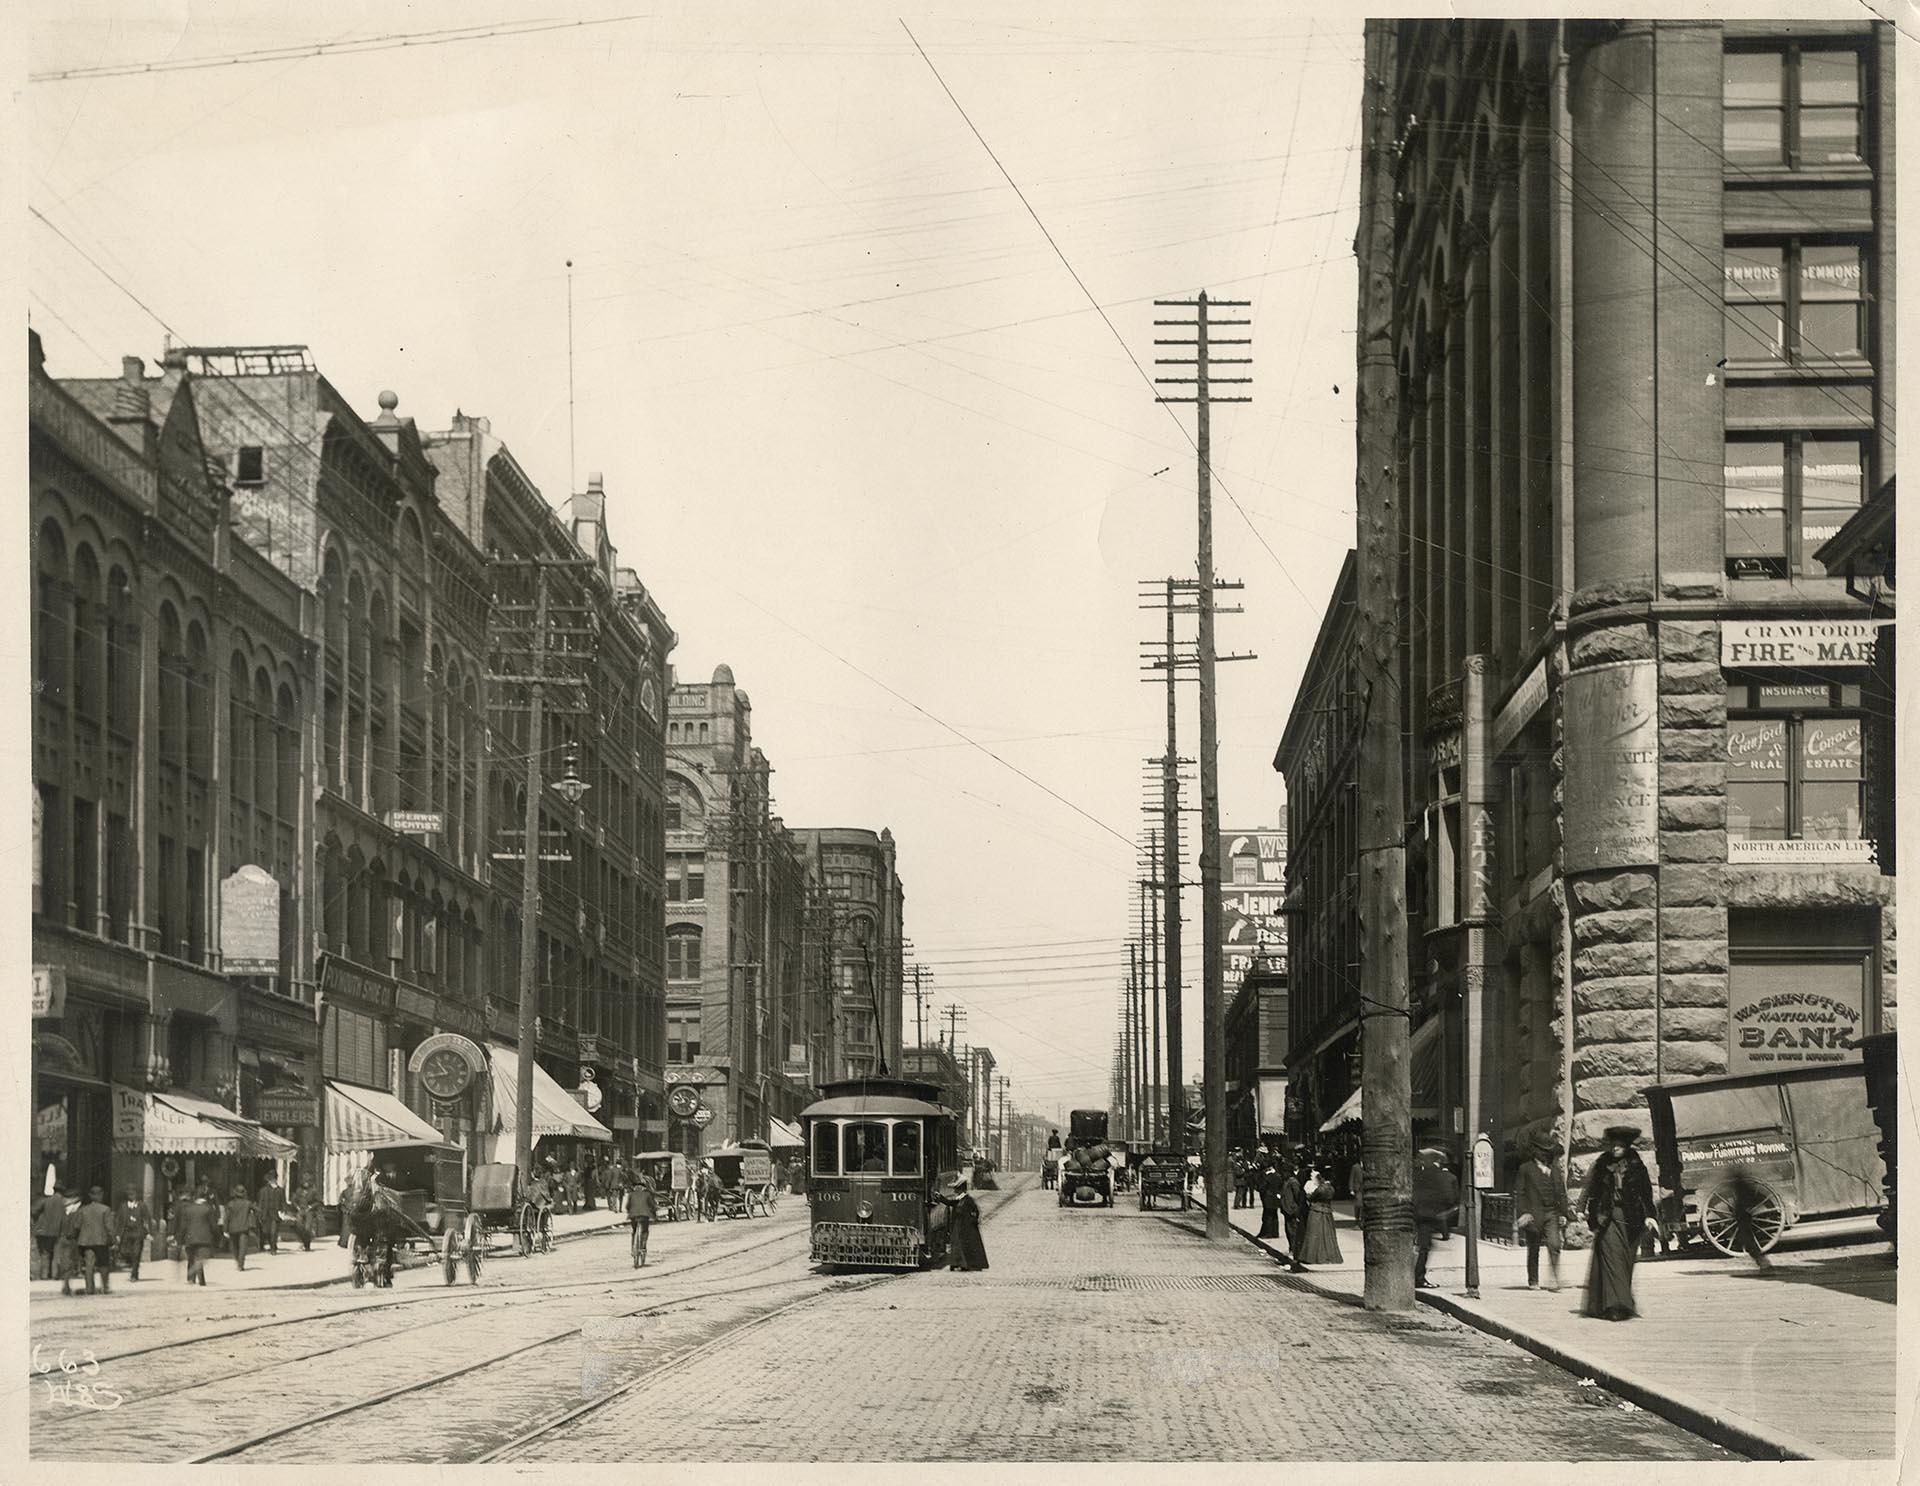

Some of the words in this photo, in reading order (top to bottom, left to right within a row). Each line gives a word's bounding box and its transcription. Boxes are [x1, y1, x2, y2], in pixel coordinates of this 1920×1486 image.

[1730, 642, 1795, 662] FIRE
[1760, 686, 1829, 697] INSURANCE
[1750, 759, 1783, 769] REAL
[1806, 759, 1854, 769] ESTATE
[1732, 842, 1775, 851] NORTH
[1777, 841, 1841, 851] AMERICAN
[1471, 809, 1496, 916] AETNA
[1733, 993, 1861, 1024] WASHINGTON
[1757, 1011, 1838, 1023] NATIONAL
[1738, 1026, 1855, 1049] BANK
[1681, 1151, 1704, 1161] PIANO
[1714, 1146, 1756, 1158] FURNITURE
[819, 1192, 841, 1201] 106
[891, 1192, 917, 1201] 106
